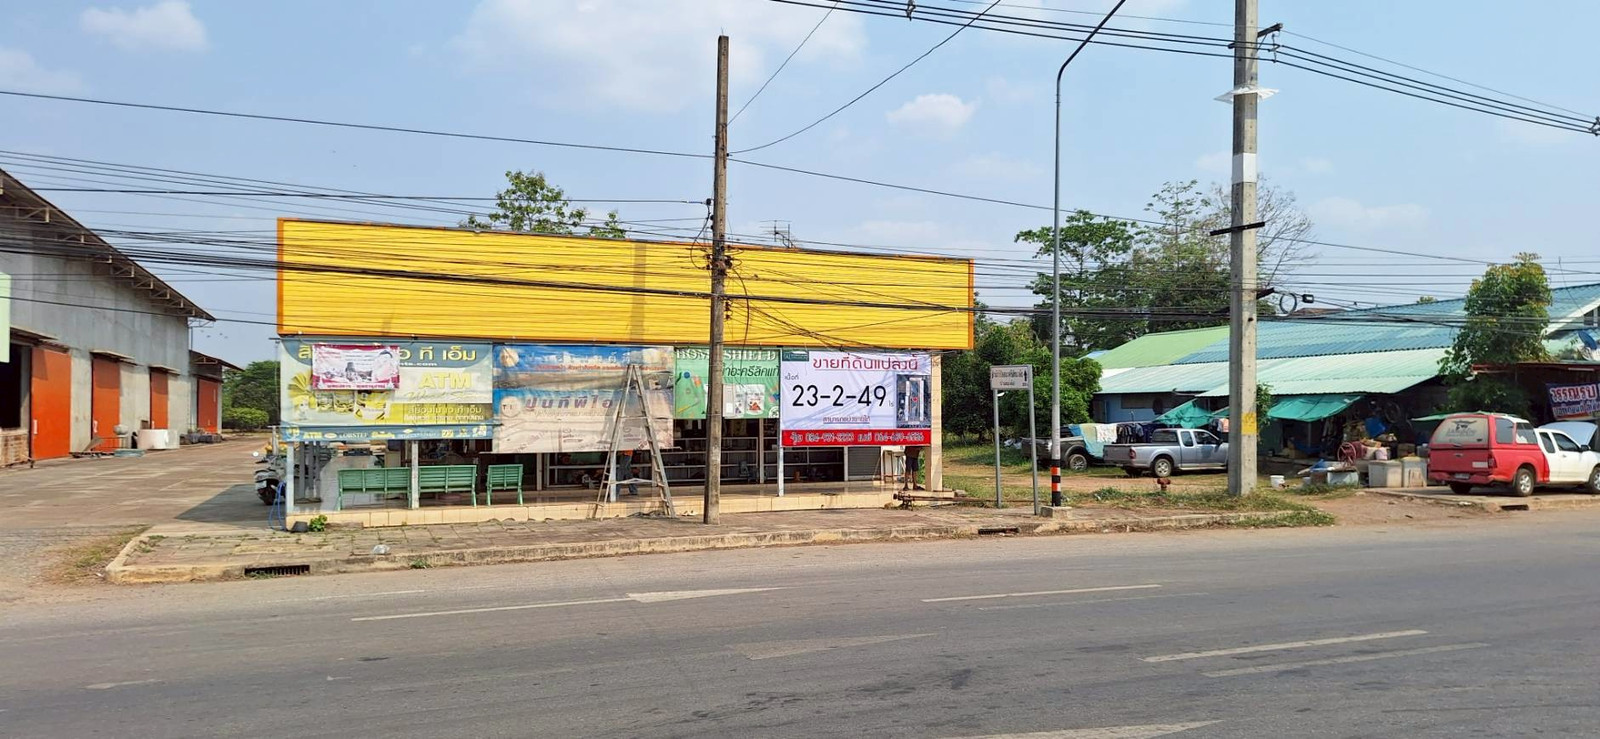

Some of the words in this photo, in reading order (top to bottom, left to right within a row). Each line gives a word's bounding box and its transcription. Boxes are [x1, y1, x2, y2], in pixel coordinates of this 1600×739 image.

[442, 345, 476, 361] เอ็ม
[676, 348, 709, 360] HOM
[724, 349, 776, 361] SHIELD
[813, 353, 918, 370] ขายที่ดินแปลงนี้
[418, 372, 472, 390] ATM
[792, 384, 887, 407] 23-2-49
